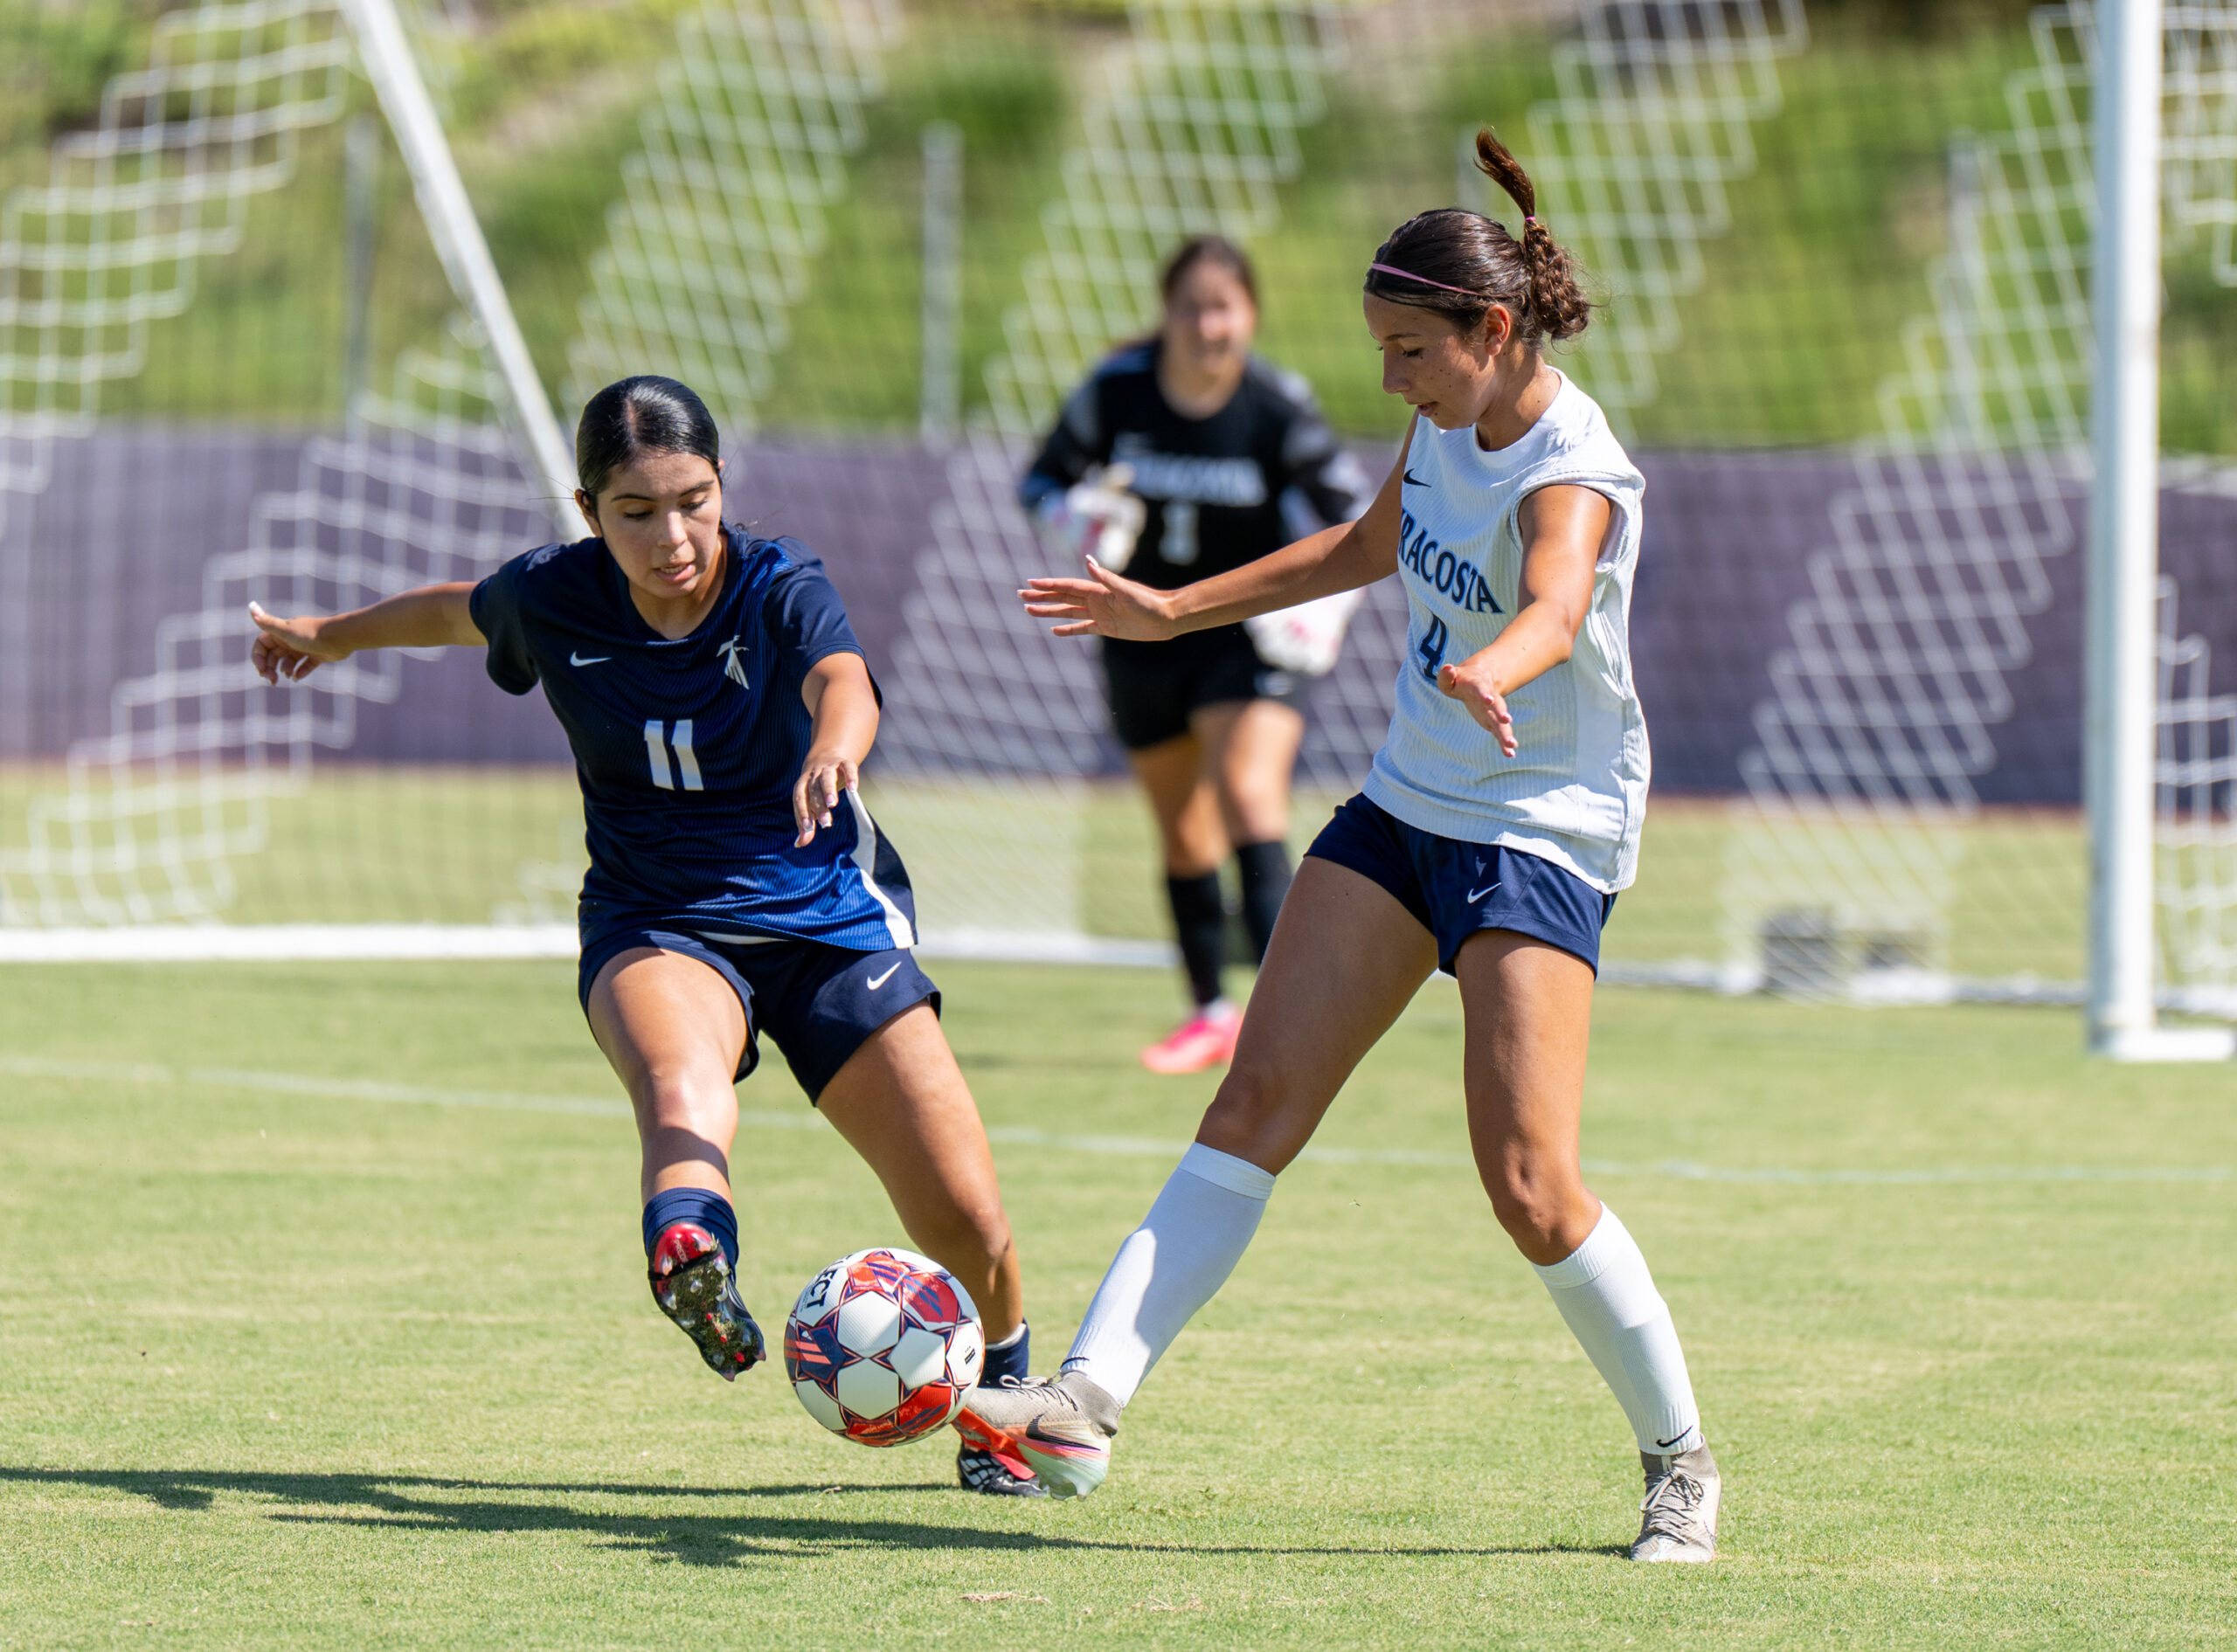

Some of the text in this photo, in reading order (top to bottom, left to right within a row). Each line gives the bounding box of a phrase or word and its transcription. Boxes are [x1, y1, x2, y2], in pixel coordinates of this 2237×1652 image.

[1399, 507, 1505, 613] RACOSTA
[1418, 613, 1447, 681] 4
[644, 719, 704, 791] 11
